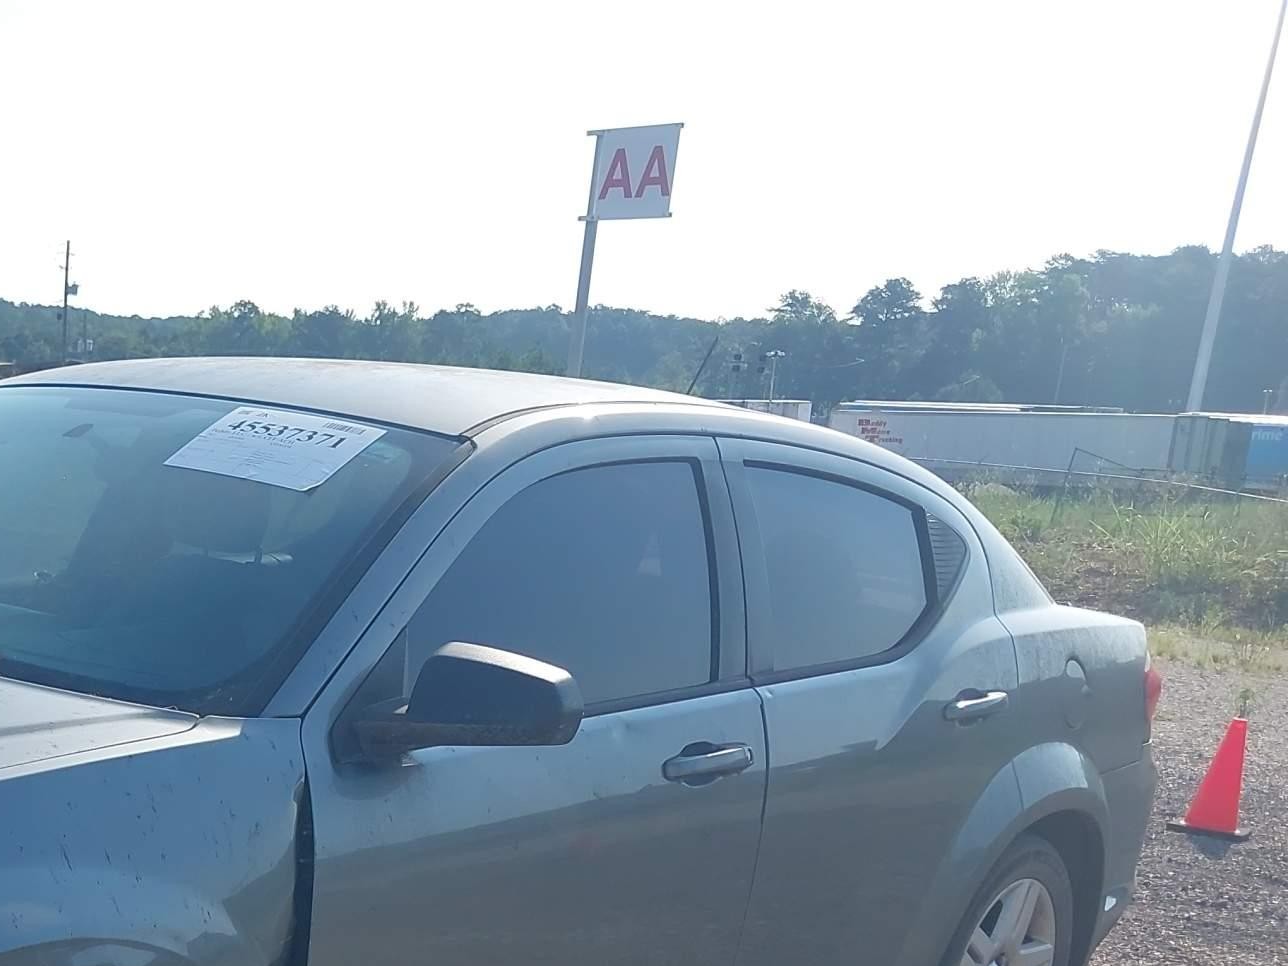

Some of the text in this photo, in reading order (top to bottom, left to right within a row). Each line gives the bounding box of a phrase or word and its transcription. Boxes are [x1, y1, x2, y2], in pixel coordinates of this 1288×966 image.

[598, 145, 670, 200] AA
[227, 419, 347, 449] 45537371
[1251, 430, 1284, 441] rime
